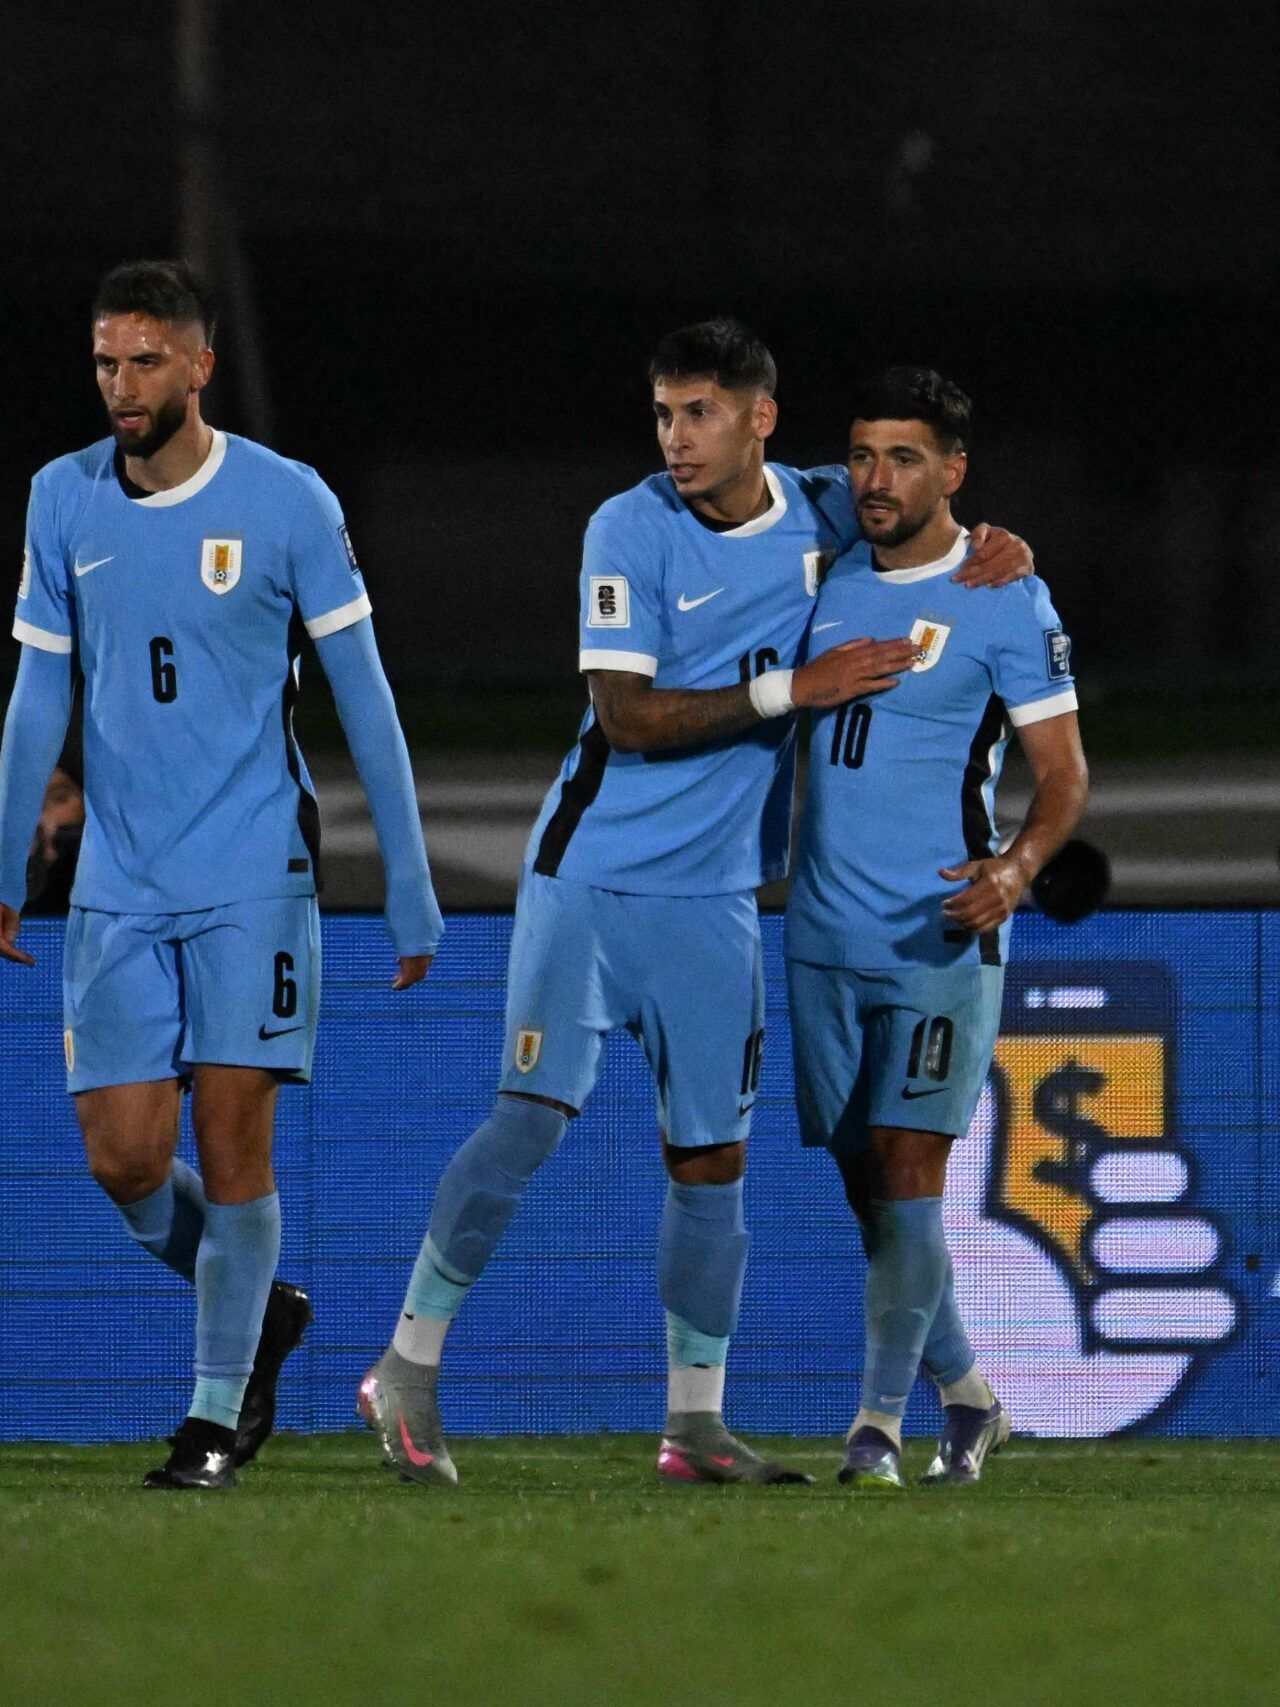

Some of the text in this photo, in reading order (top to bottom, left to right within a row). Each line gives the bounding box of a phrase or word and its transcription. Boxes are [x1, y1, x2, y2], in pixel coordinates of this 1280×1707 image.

[149, 636, 178, 704] 6
[830, 703, 873, 770] 10
[272, 951, 297, 1018] 6
[906, 1014, 953, 1082] 10
